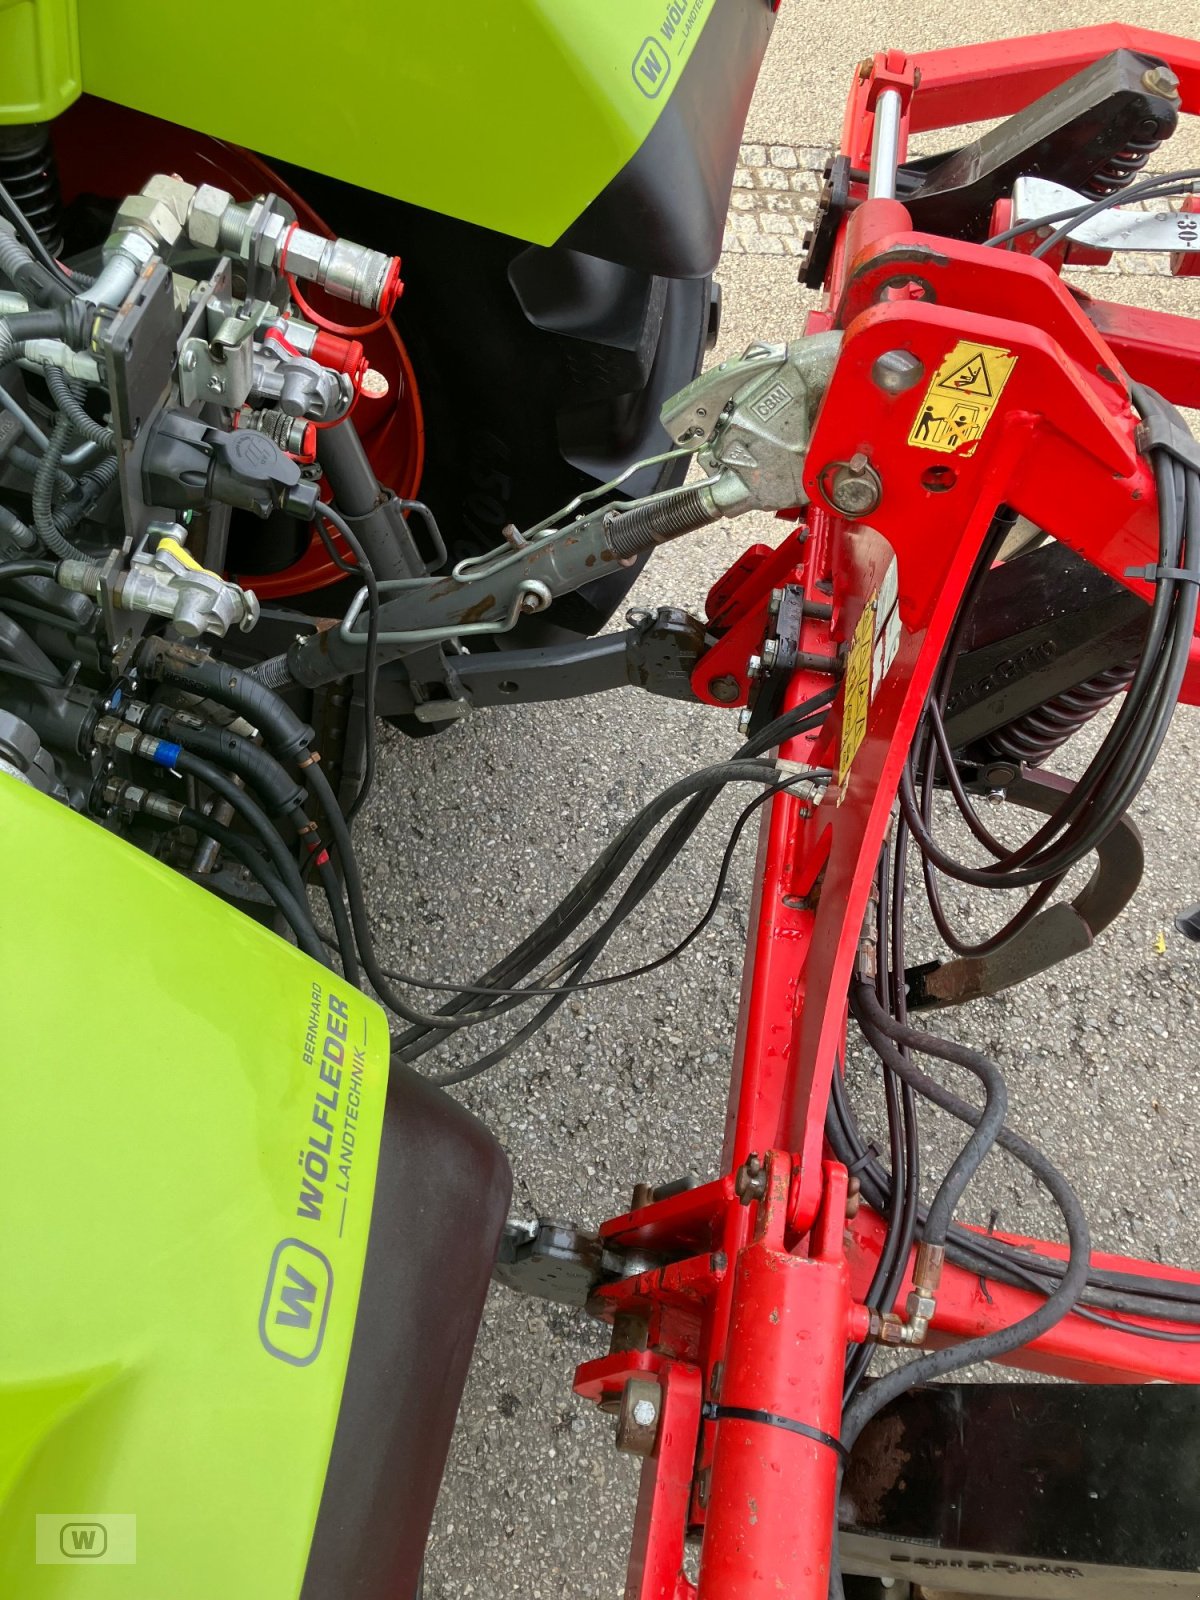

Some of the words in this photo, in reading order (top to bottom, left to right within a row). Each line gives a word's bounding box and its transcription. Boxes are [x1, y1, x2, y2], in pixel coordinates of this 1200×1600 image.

[756, 386, 789, 417] CBM
[303, 982, 322, 1065] BERNHARD
[297, 994, 349, 1221] WÖLFLEDER
[335, 1045, 367, 1193] LANDTECHNIK
[275, 1264, 318, 1330] W
